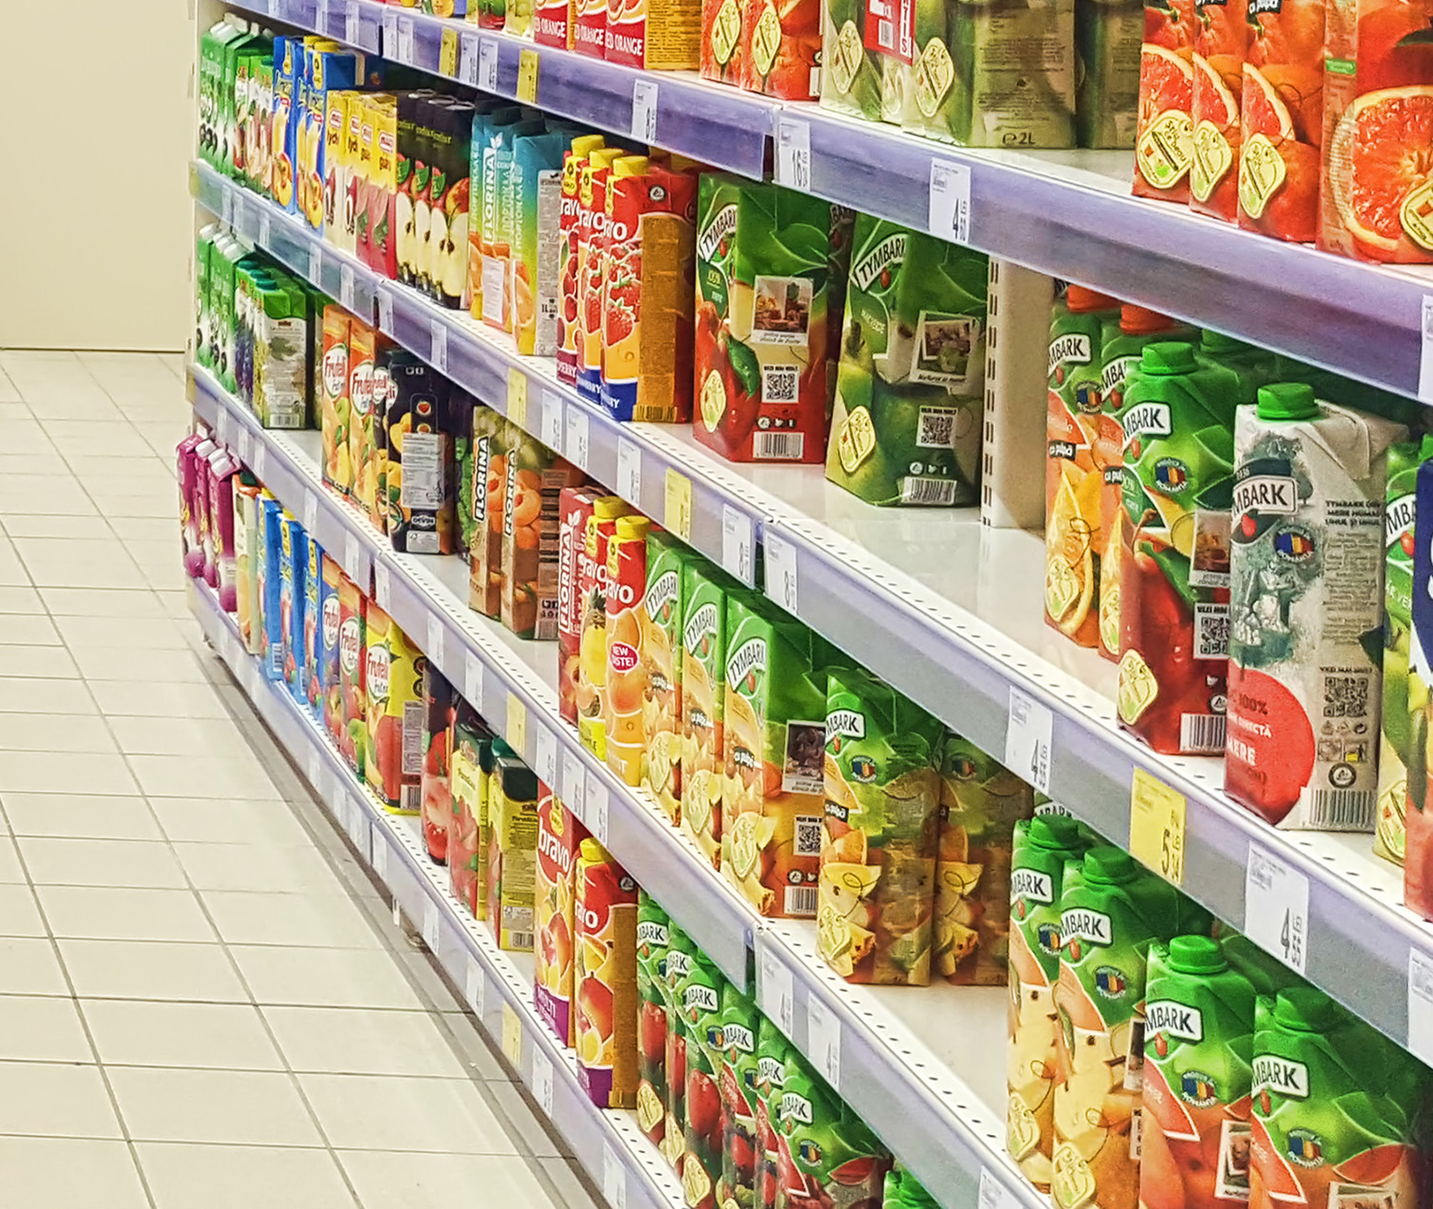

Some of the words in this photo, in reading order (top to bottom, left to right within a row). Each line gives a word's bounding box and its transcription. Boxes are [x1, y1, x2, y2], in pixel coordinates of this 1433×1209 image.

[484, 153, 496, 241] FLORINA
[475, 438, 488, 521] FLORINA
[560, 533, 573, 631] FLORINA
[1161, 835, 1171, 876] 5
[1280, 907, 1290, 960] 4
